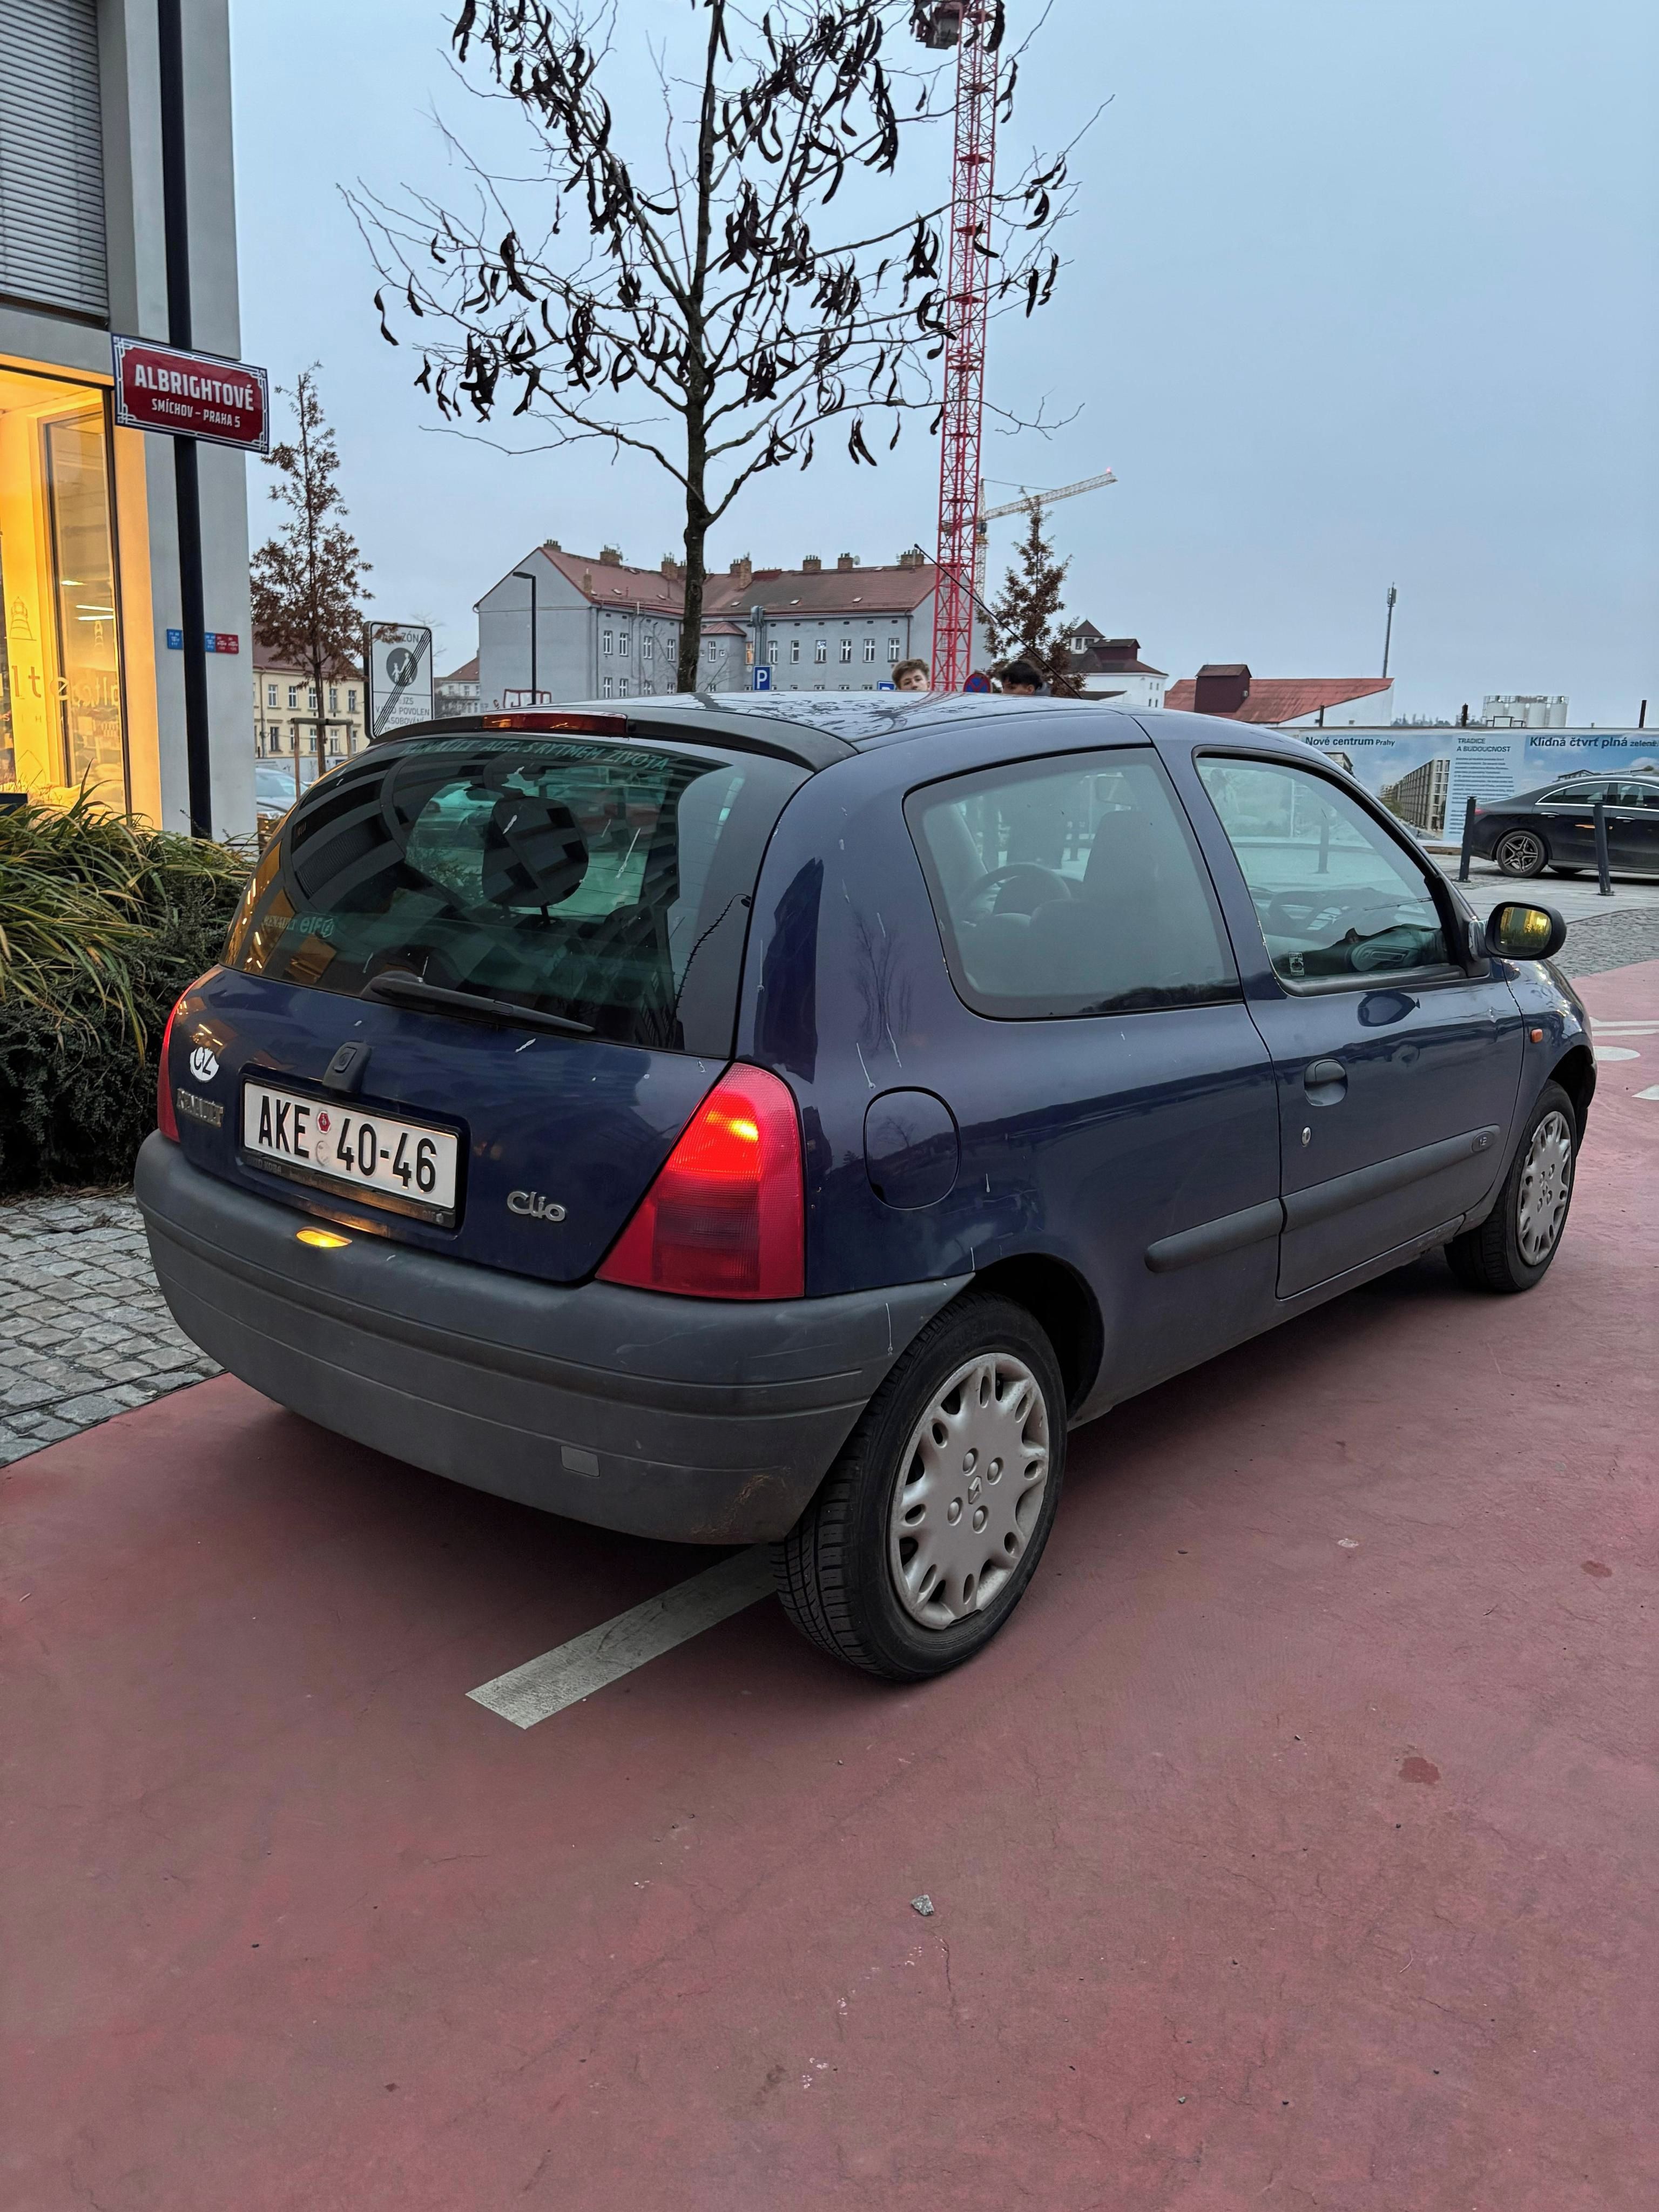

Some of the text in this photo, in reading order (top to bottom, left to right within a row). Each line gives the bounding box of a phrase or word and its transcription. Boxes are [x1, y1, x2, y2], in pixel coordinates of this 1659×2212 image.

[135, 364, 254, 411] ALBRIGHTOVÉ
[152, 399, 193, 417] SMÍCHOV
[203, 409, 232, 427] PRAHA
[234, 416, 240, 428] 5
[757, 670, 767, 689] P
[399, 707, 430, 716] POVOLEN
[1306, 737, 1330, 746] Nové
[1333, 738, 1374, 746] centrum
[1530, 737, 1566, 747] Klidná
[1569, 737, 1600, 747] čtvrť
[1601, 737, 1628, 749] plná
[536, 743, 606, 760] RYTMEM
[603, 748, 670, 770] ŽIVOTA
[258, 1095, 437, 1193] AKE 40-46
[507, 1191, 565, 1222] Clio
